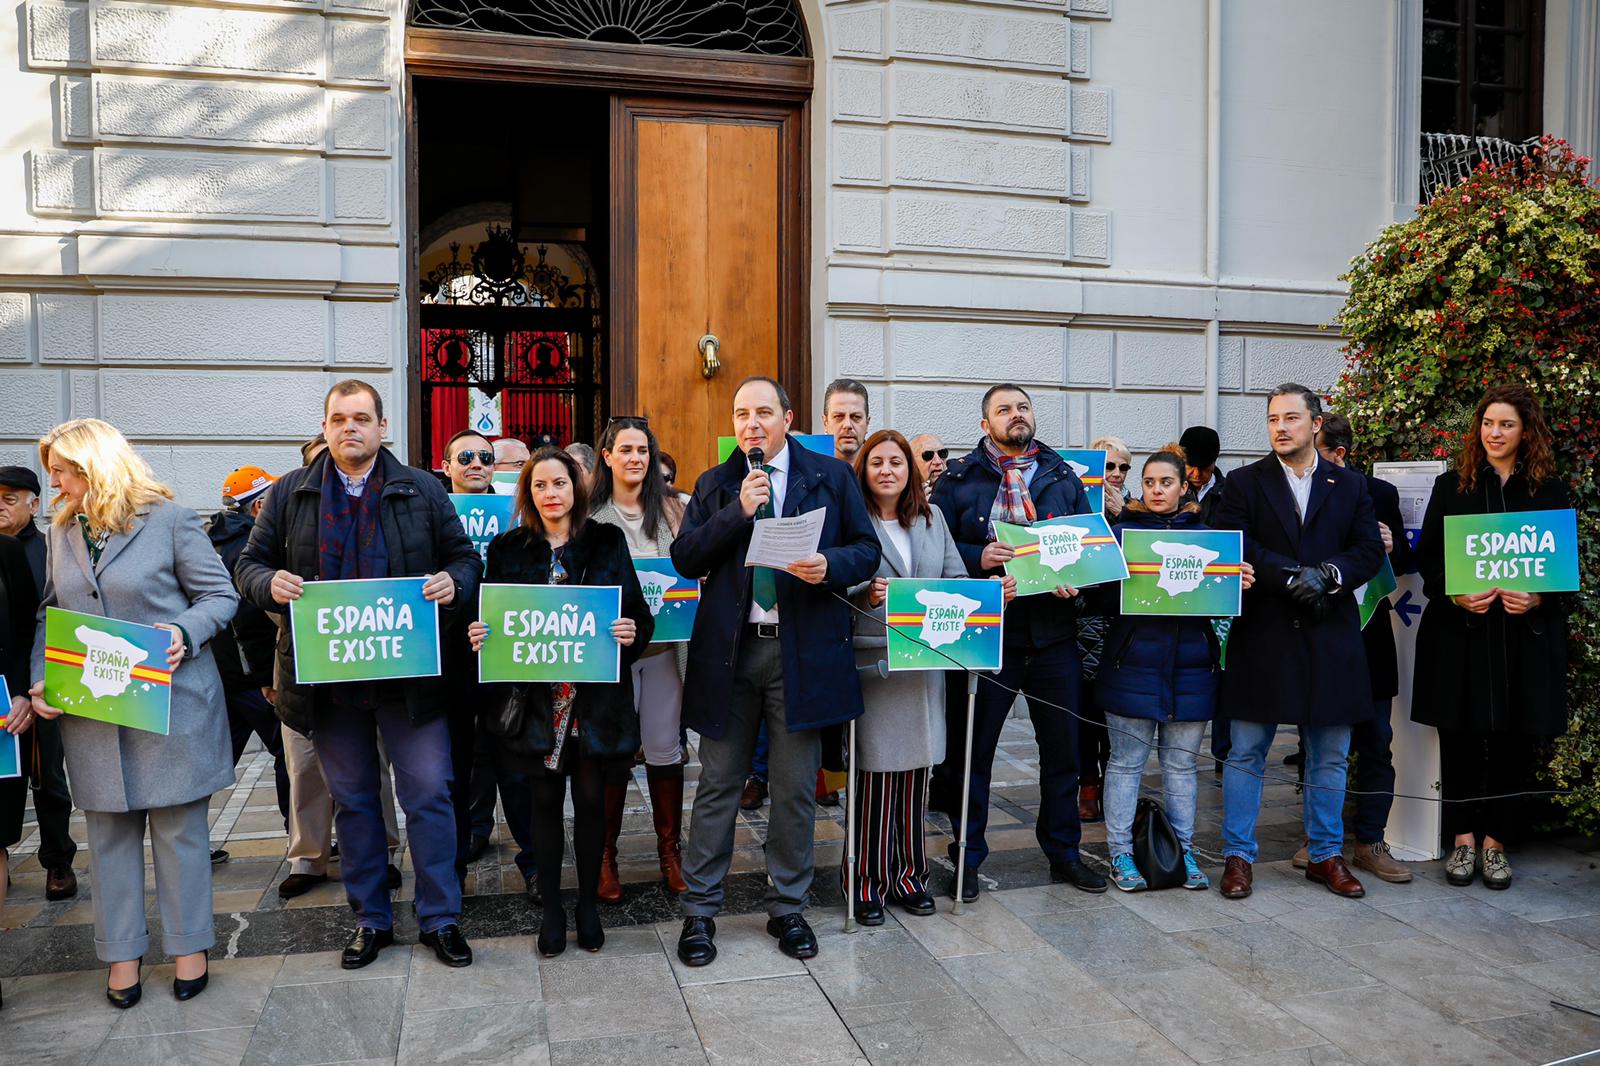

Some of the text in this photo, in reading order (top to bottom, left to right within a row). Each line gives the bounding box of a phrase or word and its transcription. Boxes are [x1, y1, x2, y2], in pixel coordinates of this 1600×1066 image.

[1042, 531, 1079, 545] ESPAÑA
[1466, 524, 1555, 557] ESPAÑA
[1048, 543, 1078, 556] EXISTE
[1165, 555, 1203, 569] ESPAÑA
[1475, 557, 1546, 580] EXISTE
[1169, 570, 1199, 580] EXISTE
[317, 596, 413, 634] ESPAÑA
[503, 603, 596, 637] ESPAÑA
[928, 604, 965, 620] ESPAÑA
[931, 621, 960, 632] EXISTE
[329, 636, 404, 663] EXISTE
[513, 640, 586, 665] EXISTE
[90, 649, 130, 669] ESPAÑA
[93, 666, 125, 682] EXISTE
